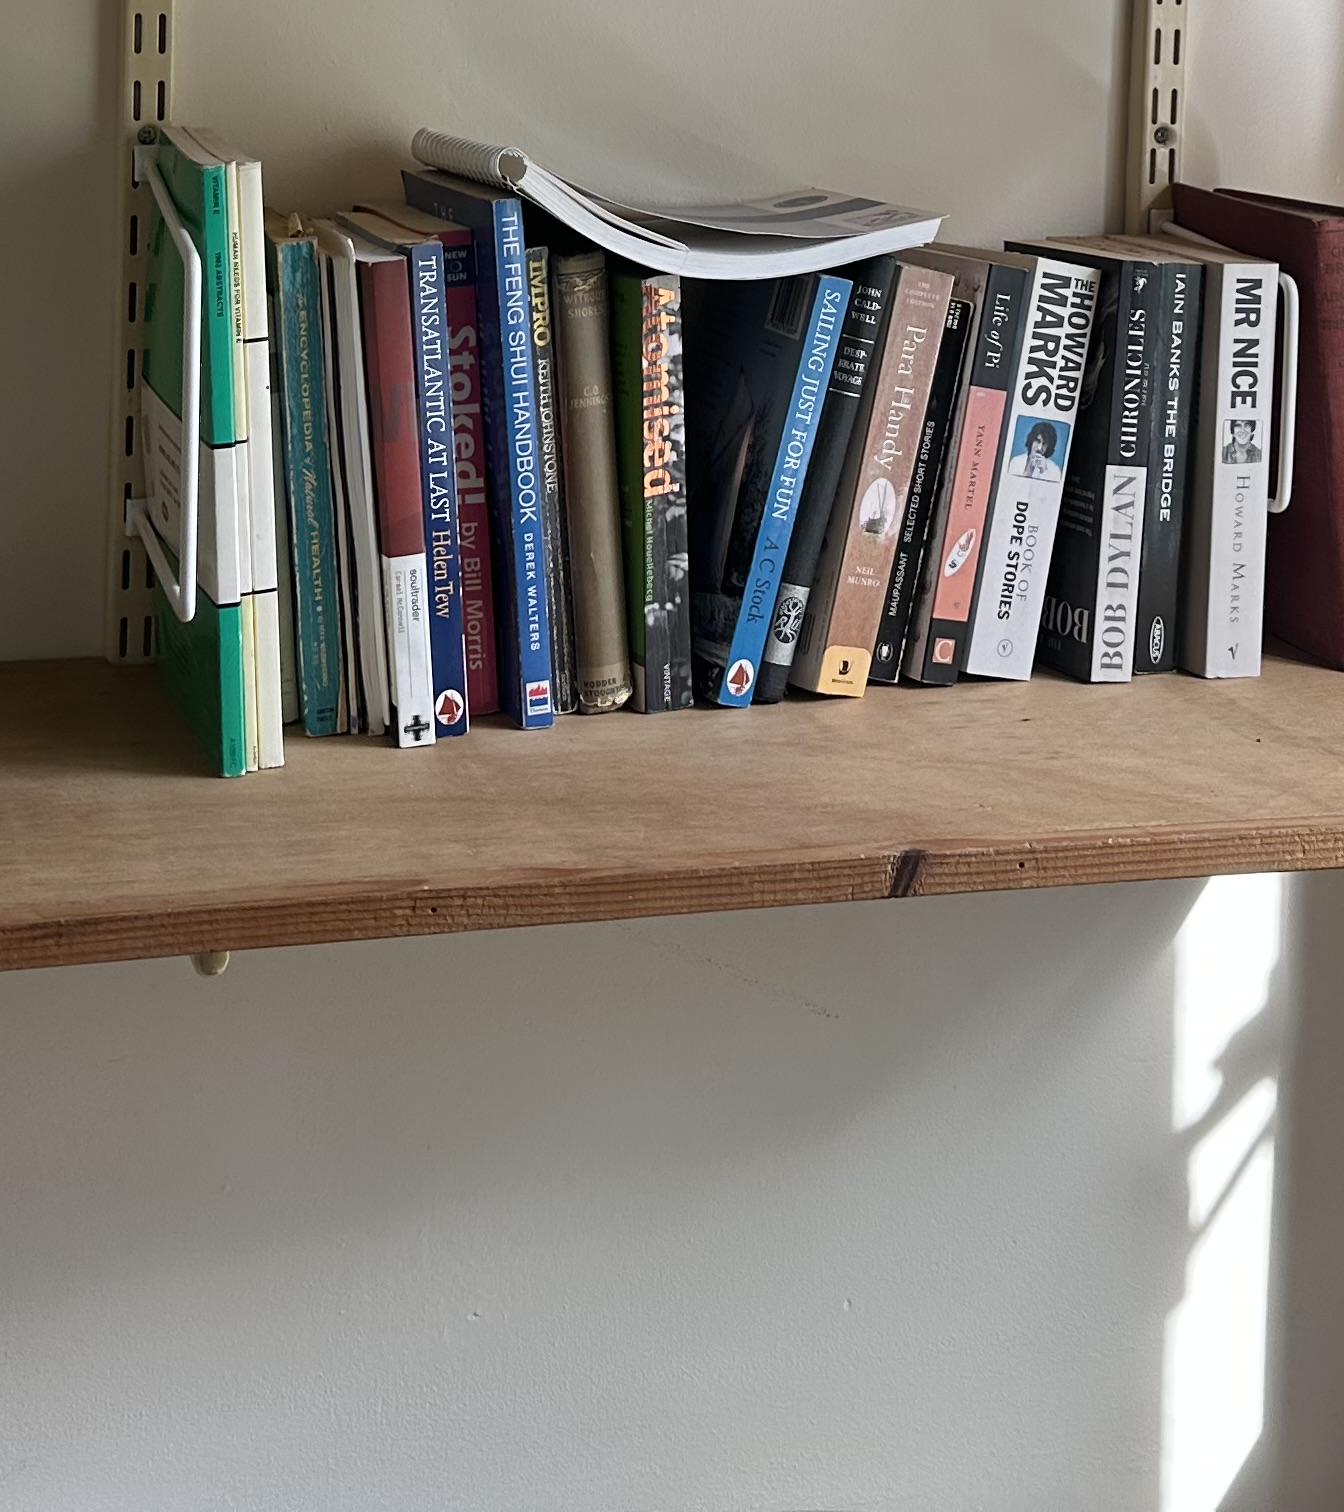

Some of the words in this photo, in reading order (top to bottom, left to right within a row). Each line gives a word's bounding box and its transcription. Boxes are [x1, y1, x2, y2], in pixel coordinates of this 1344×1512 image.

[445, 250, 467, 259] NEW
[501, 211, 520, 257] THE
[215, 267, 225, 318] ABSTRACTS
[231, 232, 239, 261] HUMAN
[235, 304, 243, 337] VITAMIN
[447, 272, 467, 282] SUN
[505, 265, 524, 325] FENG
[857, 285, 882, 298] JOHN
[1074, 276, 1097, 292] THE
[1172, 271, 1187, 316] IAIN
[529, 259, 552, 348] IMPRO
[851, 310, 877, 325] WELL
[991, 292, 1012, 328] Life
[1234, 277, 1263, 329] MR
[417, 255, 446, 434] TRANSATLANTIC
[808, 289, 841, 372] SAILING
[896, 324, 928, 378] Para
[984, 329, 1004, 353] of
[1022, 270, 1073, 409] MARKS
[1054, 290, 1094, 413] HOWARD
[508, 331, 528, 384] SHUI
[833, 370, 864, 386] VOYAGE
[837, 358, 866, 373] ERATE
[984, 350, 1001, 370] Pi
[1167, 320, 1184, 392] BANKS
[1229, 338, 1263, 410] NICE
[642, 286, 681, 499] Atomised
[795, 375, 820, 425] JUST
[1119, 308, 1147, 459] CHRONICLES
[873, 384, 916, 471] Handy
[974, 424, 987, 458] YANN
[1163, 395, 1179, 439] THE
[299, 310, 315, 454] ENCYCLOPEDIA
[310, 530, 323, 602] HEALTH
[426, 439, 448, 466] AT
[513, 392, 538, 524] HANDBOOK
[540, 406, 558, 494] JOHNSTONE
[782, 428, 808, 470] FOR
[428, 471, 451, 523] LAST
[772, 474, 798, 521] FUN
[964, 459, 981, 511] MARTEL
[1158, 444, 1176, 524] BRIDGE
[461, 522, 479, 550] by
[646, 499, 654, 535] Michel
[888, 551, 910, 617] MAUPASSANT
[903, 495, 920, 544] SELECTED
[912, 456, 930, 494] SHORT
[921, 420, 936, 459] STORIES
[1008, 501, 1029, 546] DOPE
[1104, 474, 1137, 593] DYLAN
[1232, 475, 1253, 555] HOWARD
[432, 528, 452, 582] Helen
[523, 532, 536, 581] DEREK
[759, 557, 775, 574] C
[763, 536, 780, 552] A
[1023, 524, 1040, 571] BOOK
[462, 557, 482, 591] Bill
[846, 575, 881, 589] MUNRO
[855, 564, 876, 576] NEIL
[997, 548, 1022, 621] STORIES
[1018, 575, 1032, 602] OF
[1229, 561, 1246, 625] MARKS
[409, 569, 420, 622] soultrader
[433, 581, 455, 619] Tew
[526, 585, 541, 651] WALTERS
[746, 577, 771, 625] Stock
[464, 599, 484, 672] Morris
[1099, 601, 1131, 672] BOB
[663, 663, 672, 703] VINTAGE
